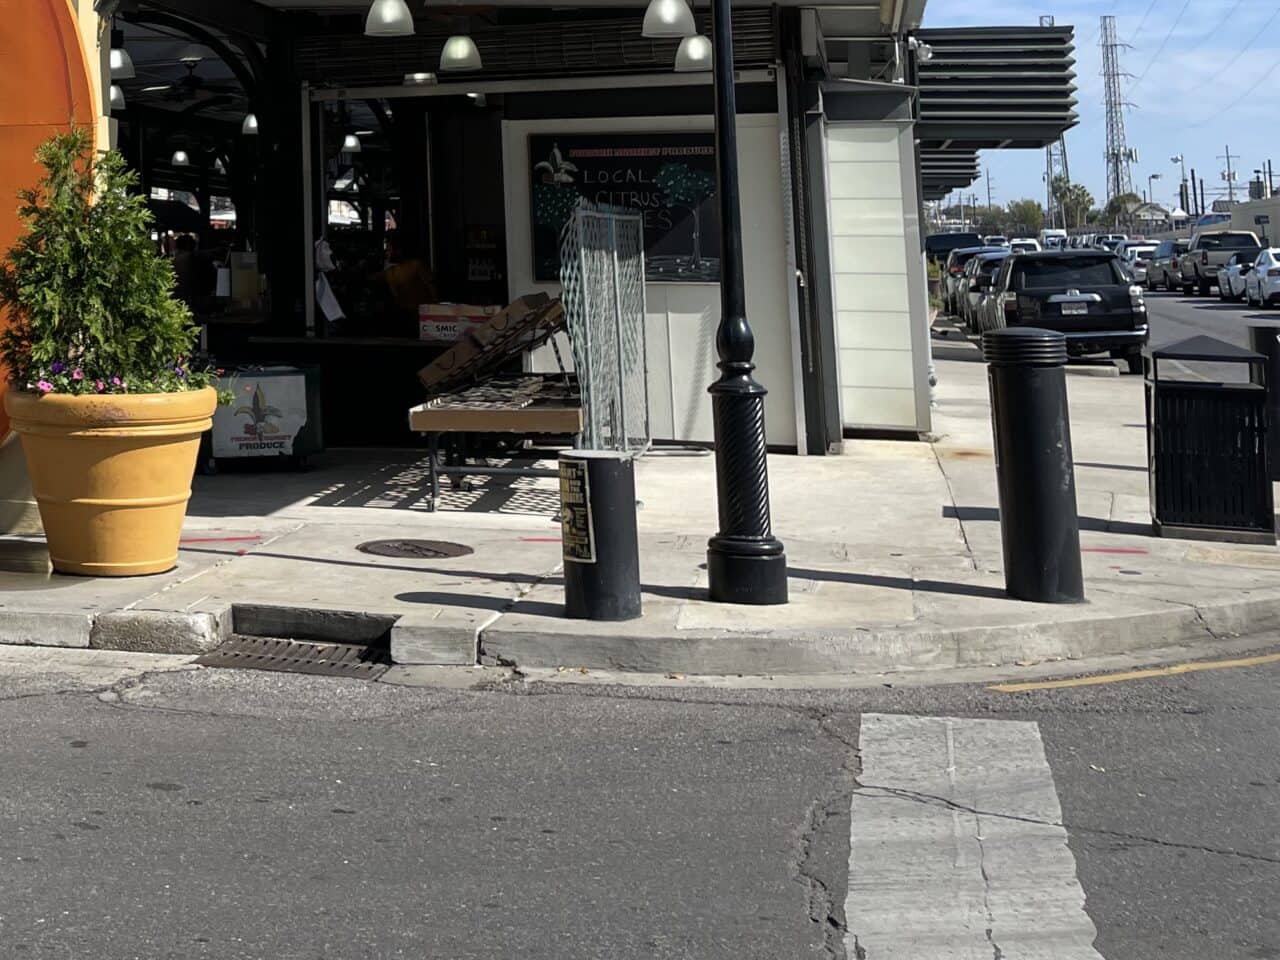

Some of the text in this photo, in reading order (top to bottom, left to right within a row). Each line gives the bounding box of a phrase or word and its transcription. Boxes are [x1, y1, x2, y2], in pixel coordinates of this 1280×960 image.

[584, 168, 652, 183] LOCAL
[595, 191, 661, 208] CITRUS
[239, 441, 285, 450] PRODUCE
